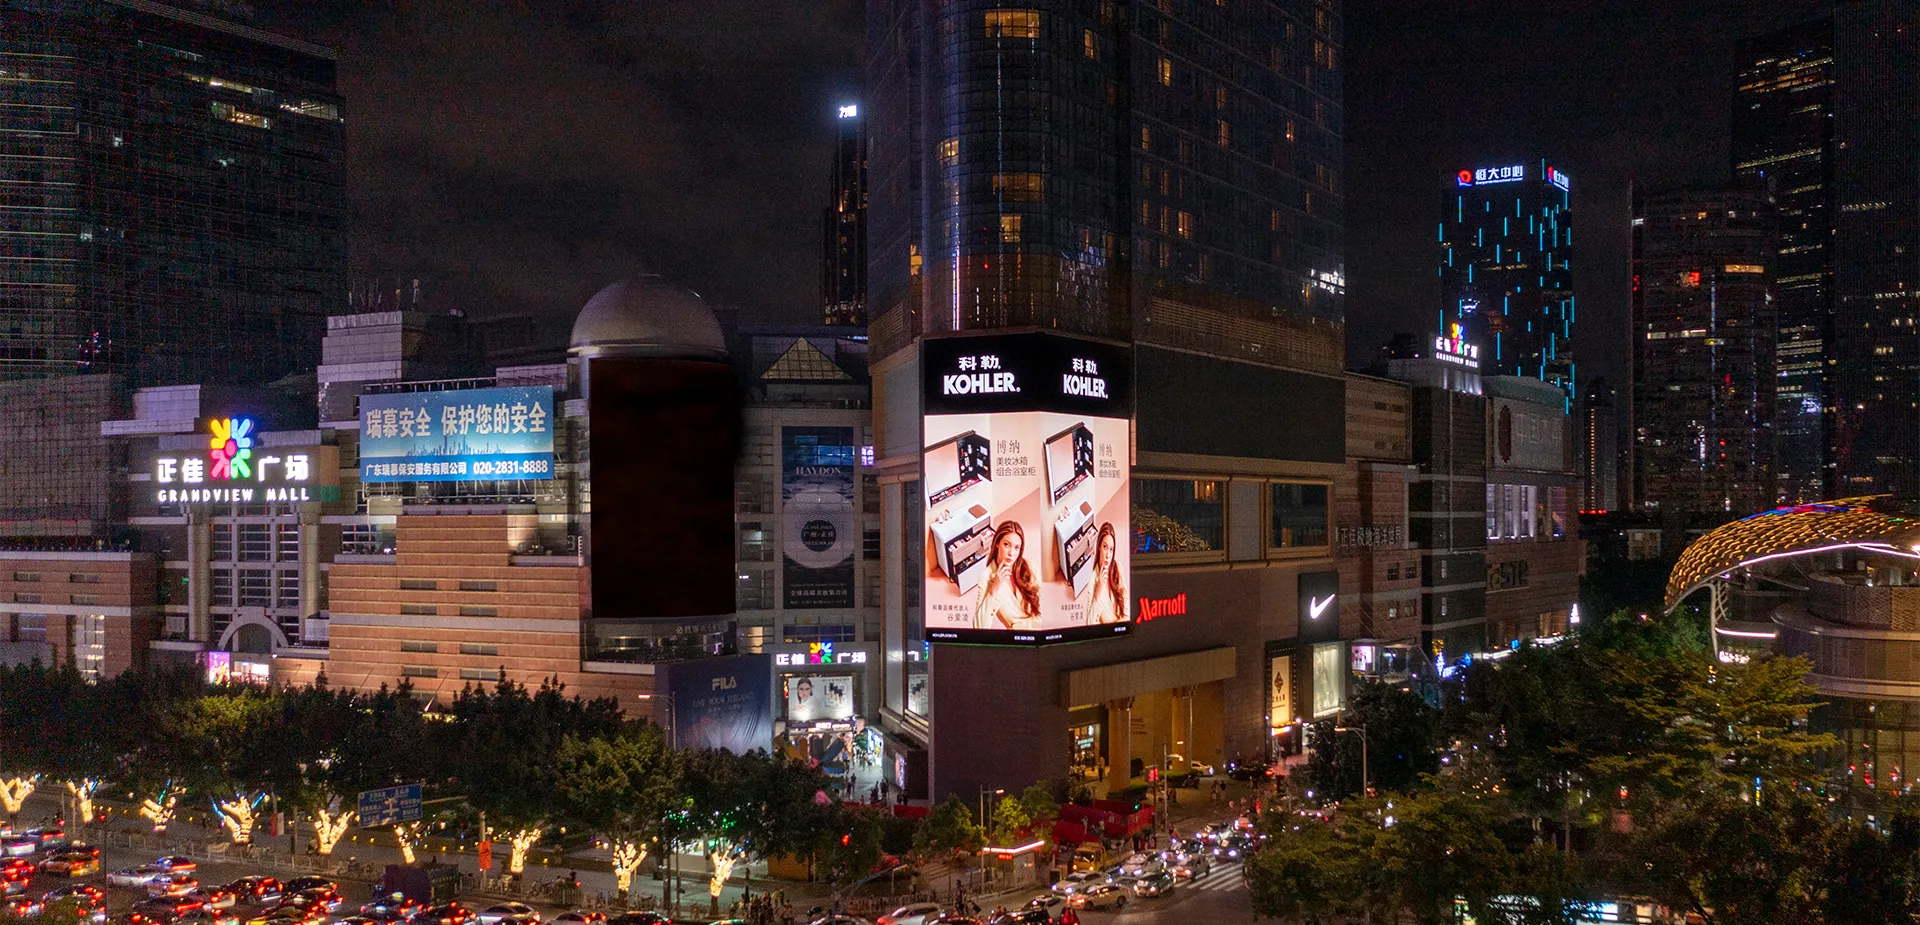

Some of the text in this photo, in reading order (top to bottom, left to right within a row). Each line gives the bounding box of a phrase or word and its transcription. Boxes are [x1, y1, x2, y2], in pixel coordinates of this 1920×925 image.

[1475, 165, 1523, 181] 恒大中心
[367, 401, 547, 439] 瑞慕安全 保护您的安全
[996, 440, 1020, 454] 博纳
[473, 460, 548, 475] 020-2831-8888
[996, 456, 1028, 466] 美妆冰箱
[158, 455, 309, 483] 正佳 广场
[366, 462, 467, 476] 广东瑞慕保安服务有限公司
[796, 466, 841, 475] HAYDON
[996, 466, 1036, 477] 组合浴室柜
[158, 487, 310, 503] GRANDVIEW MALL
[1136, 592, 1187, 624] Marriott
[947, 613, 969, 622] 谷爱凌
[776, 652, 867, 666] 正佳 广场
[711, 676, 738, 691] FILA
